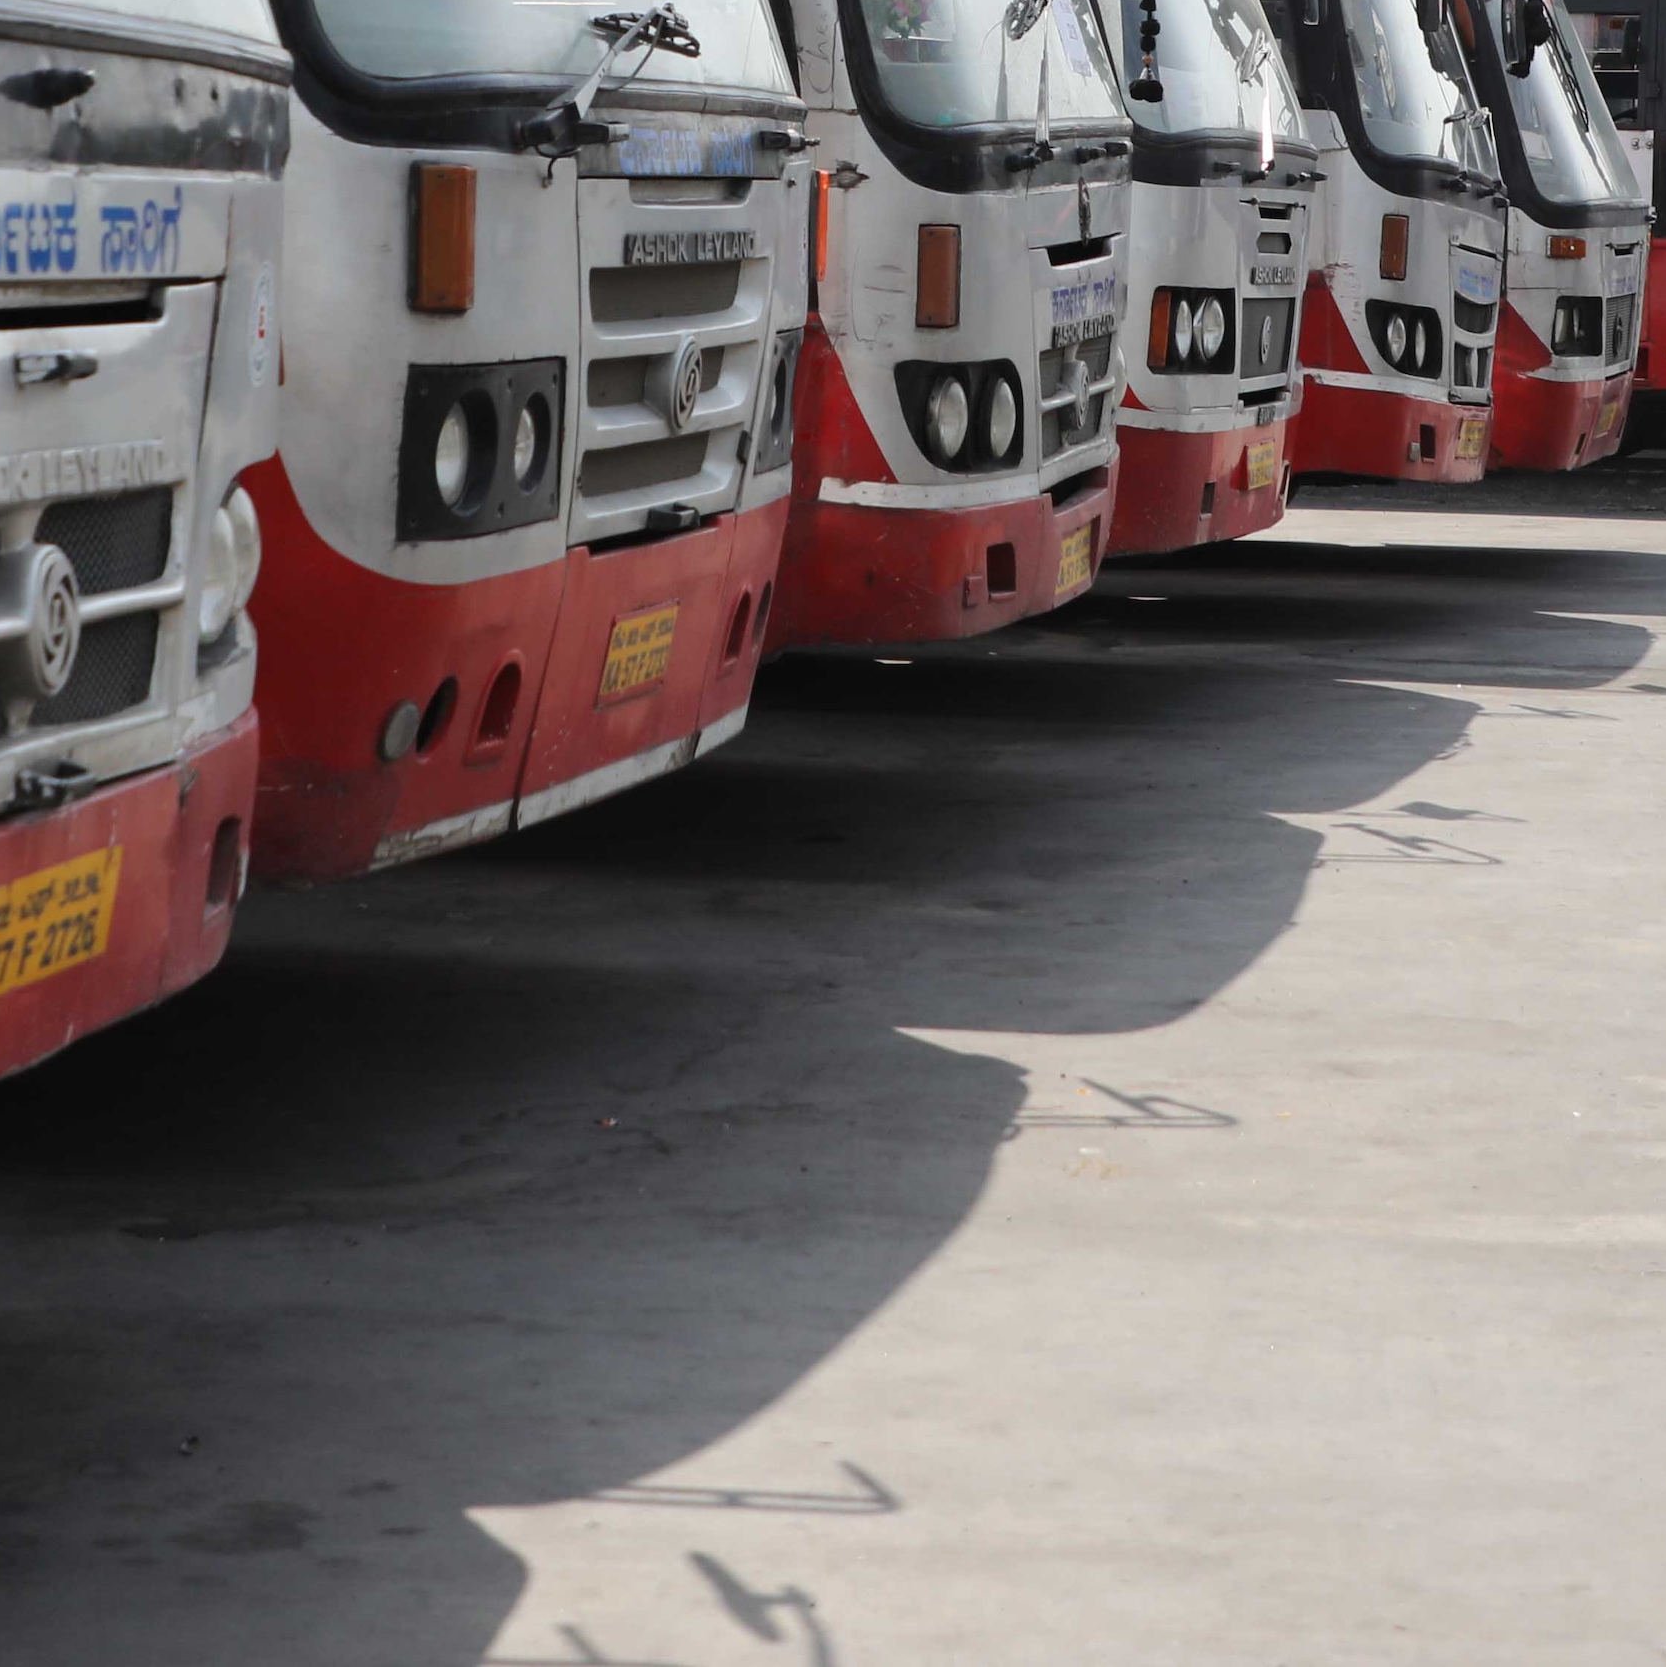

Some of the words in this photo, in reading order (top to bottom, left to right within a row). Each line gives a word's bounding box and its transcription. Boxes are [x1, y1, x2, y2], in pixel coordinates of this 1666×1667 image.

[99, 185, 183, 274] ಸಾರಿಗೆ
[632, 231, 689, 265] ASHOK
[697, 230, 757, 261] LEYLAND
[43, 439, 171, 496] LEYLAND
[17, 930, 38, 977] F
